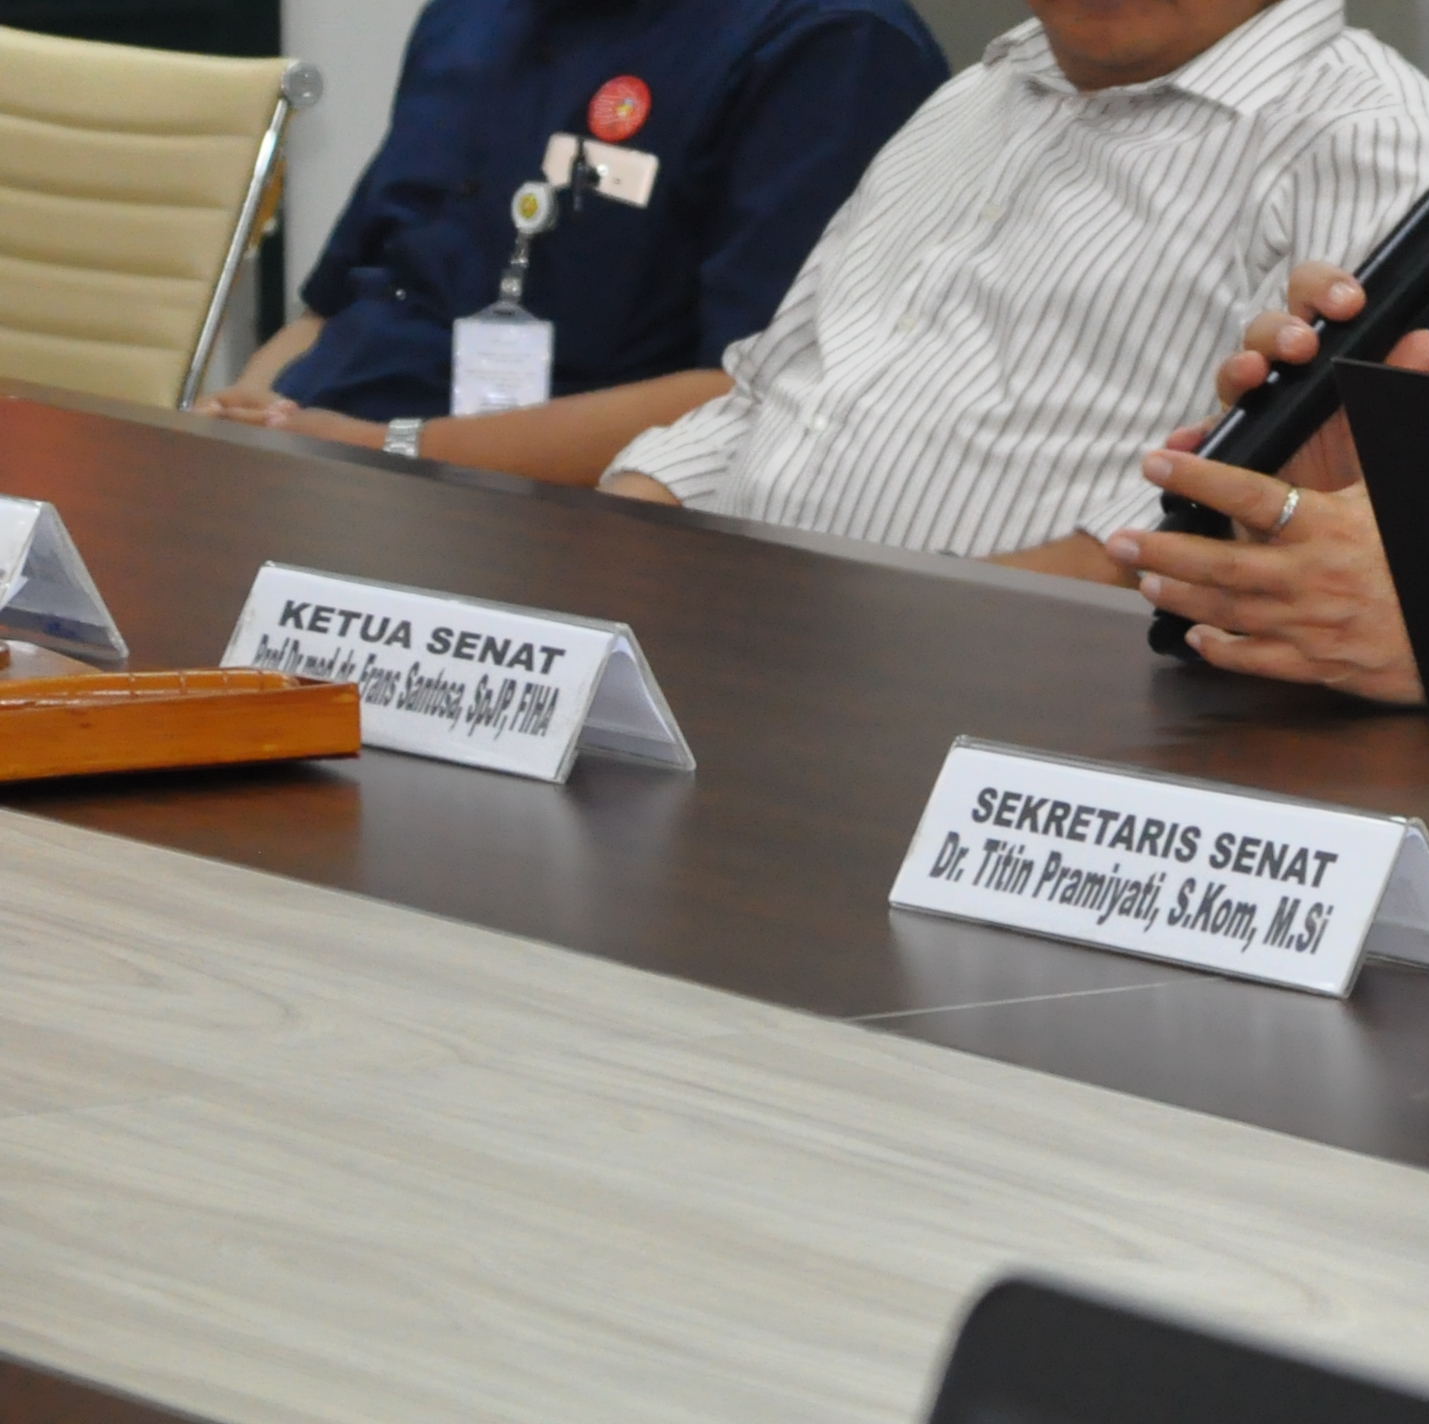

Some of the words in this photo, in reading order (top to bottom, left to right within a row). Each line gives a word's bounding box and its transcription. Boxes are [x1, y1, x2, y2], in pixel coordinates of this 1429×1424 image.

[278, 598, 413, 649] KETUA
[426, 626, 567, 676] SENAT
[359, 652, 402, 708] Frans
[400, 661, 466, 730] Santosa,
[509, 681, 561, 738] FIHA
[970, 786, 1202, 864] SEKRETARIS
[1208, 832, 1339, 890] SENAT
[928, 830, 965, 880] Dr.
[972, 838, 1034, 896] Titin
[1032, 850, 1165, 933] Pramiyati,
[1166, 877, 1260, 954] S.Kom,
[1262, 895, 1334, 956] M.Si
